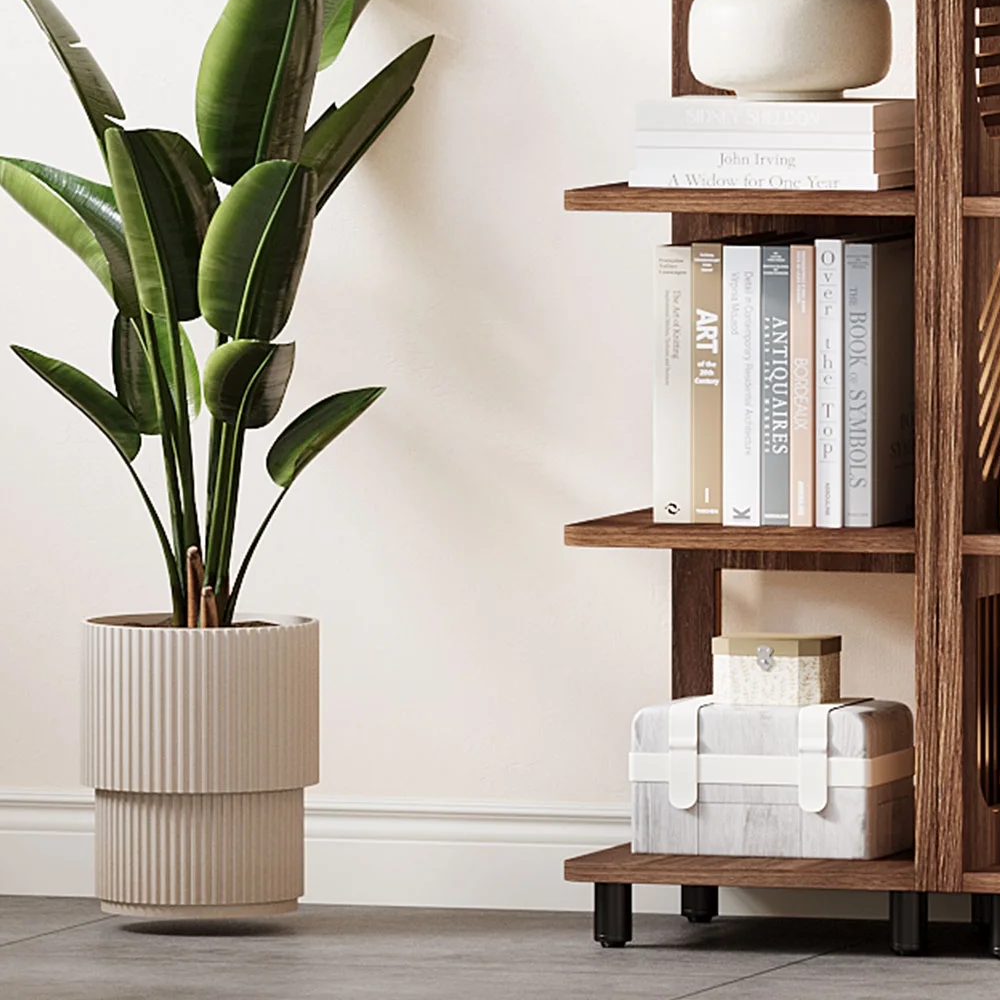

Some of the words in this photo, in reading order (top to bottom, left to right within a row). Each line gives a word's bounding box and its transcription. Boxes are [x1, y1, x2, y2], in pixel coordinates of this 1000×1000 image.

[668, 173, 680, 187] A
[684, 173, 740, 188] Widow
[743, 174, 763, 188] for
[768, 176, 801, 189] One
[807, 176, 841, 189] Year
[717, 152, 750, 168] John
[754, 153, 796, 168] Irving
[744, 271, 755, 294] Detail
[849, 288, 857, 306] THE
[696, 309, 719, 354] ART
[742, 305, 754, 361] Contemporary
[849, 312, 867, 367] BOOK
[770, 317, 788, 454] ANTIQUAIRES
[794, 358, 809, 430] BORDEAUX
[849, 390, 868, 488] SYMBOLS
[733, 507, 751, 519] K
